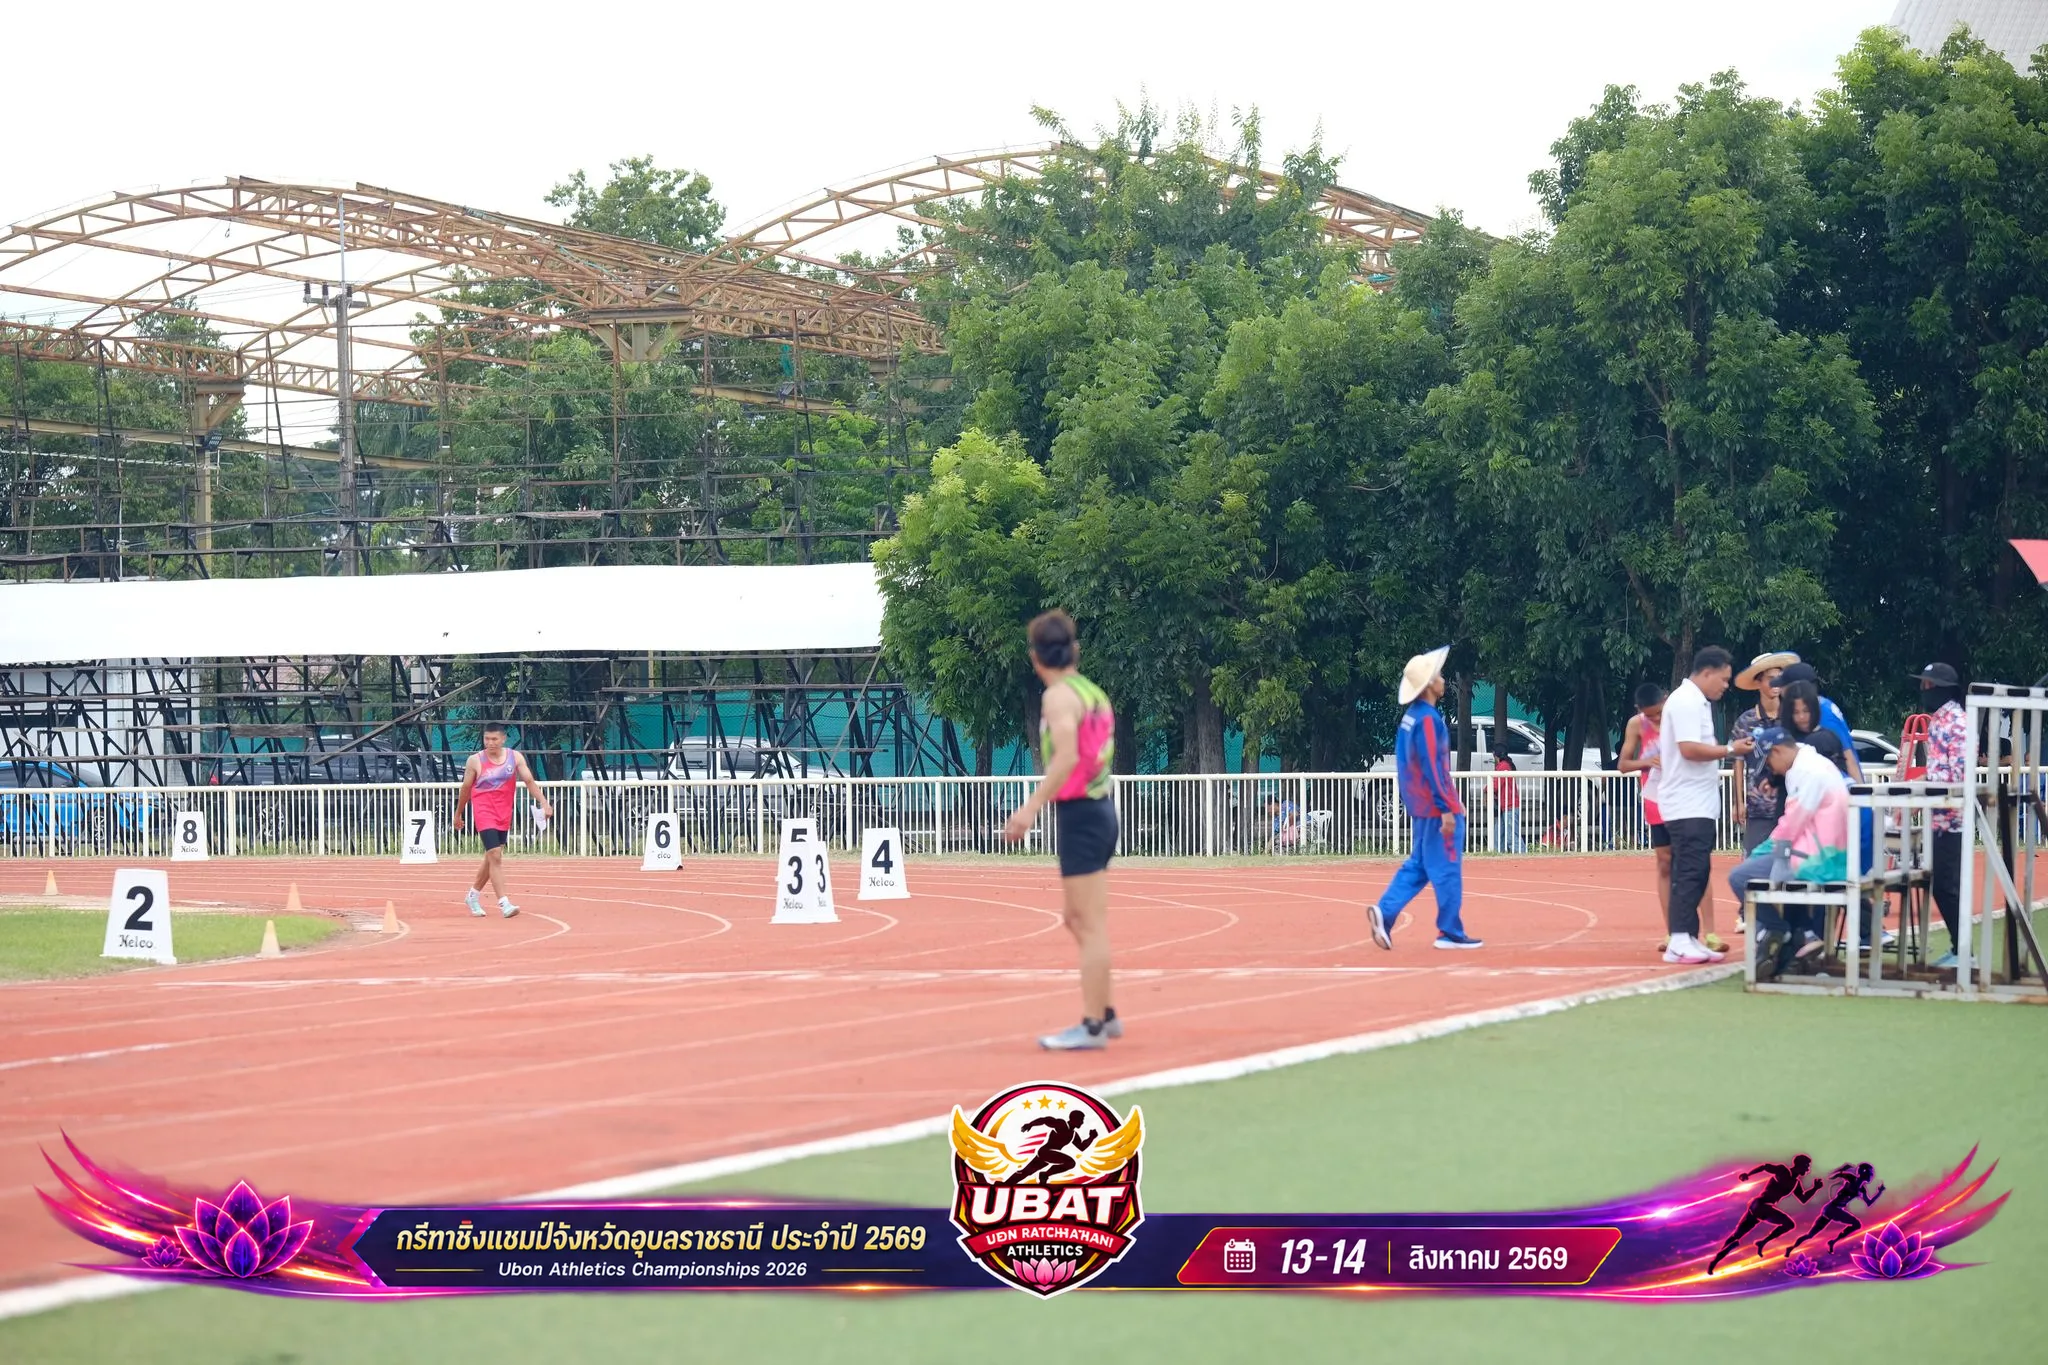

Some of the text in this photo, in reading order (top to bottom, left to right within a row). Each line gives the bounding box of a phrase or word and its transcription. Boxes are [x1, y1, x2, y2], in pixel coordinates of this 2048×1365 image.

[183, 820, 198, 844] 8
[411, 819, 426, 845] 7
[655, 820, 671, 849] 6
[871, 839, 893, 875] 4
[787, 855, 803, 895] 3
[815, 854, 826, 893] 3
[124, 885, 154, 931] 2
[118, 934, 154, 949] Nelco
